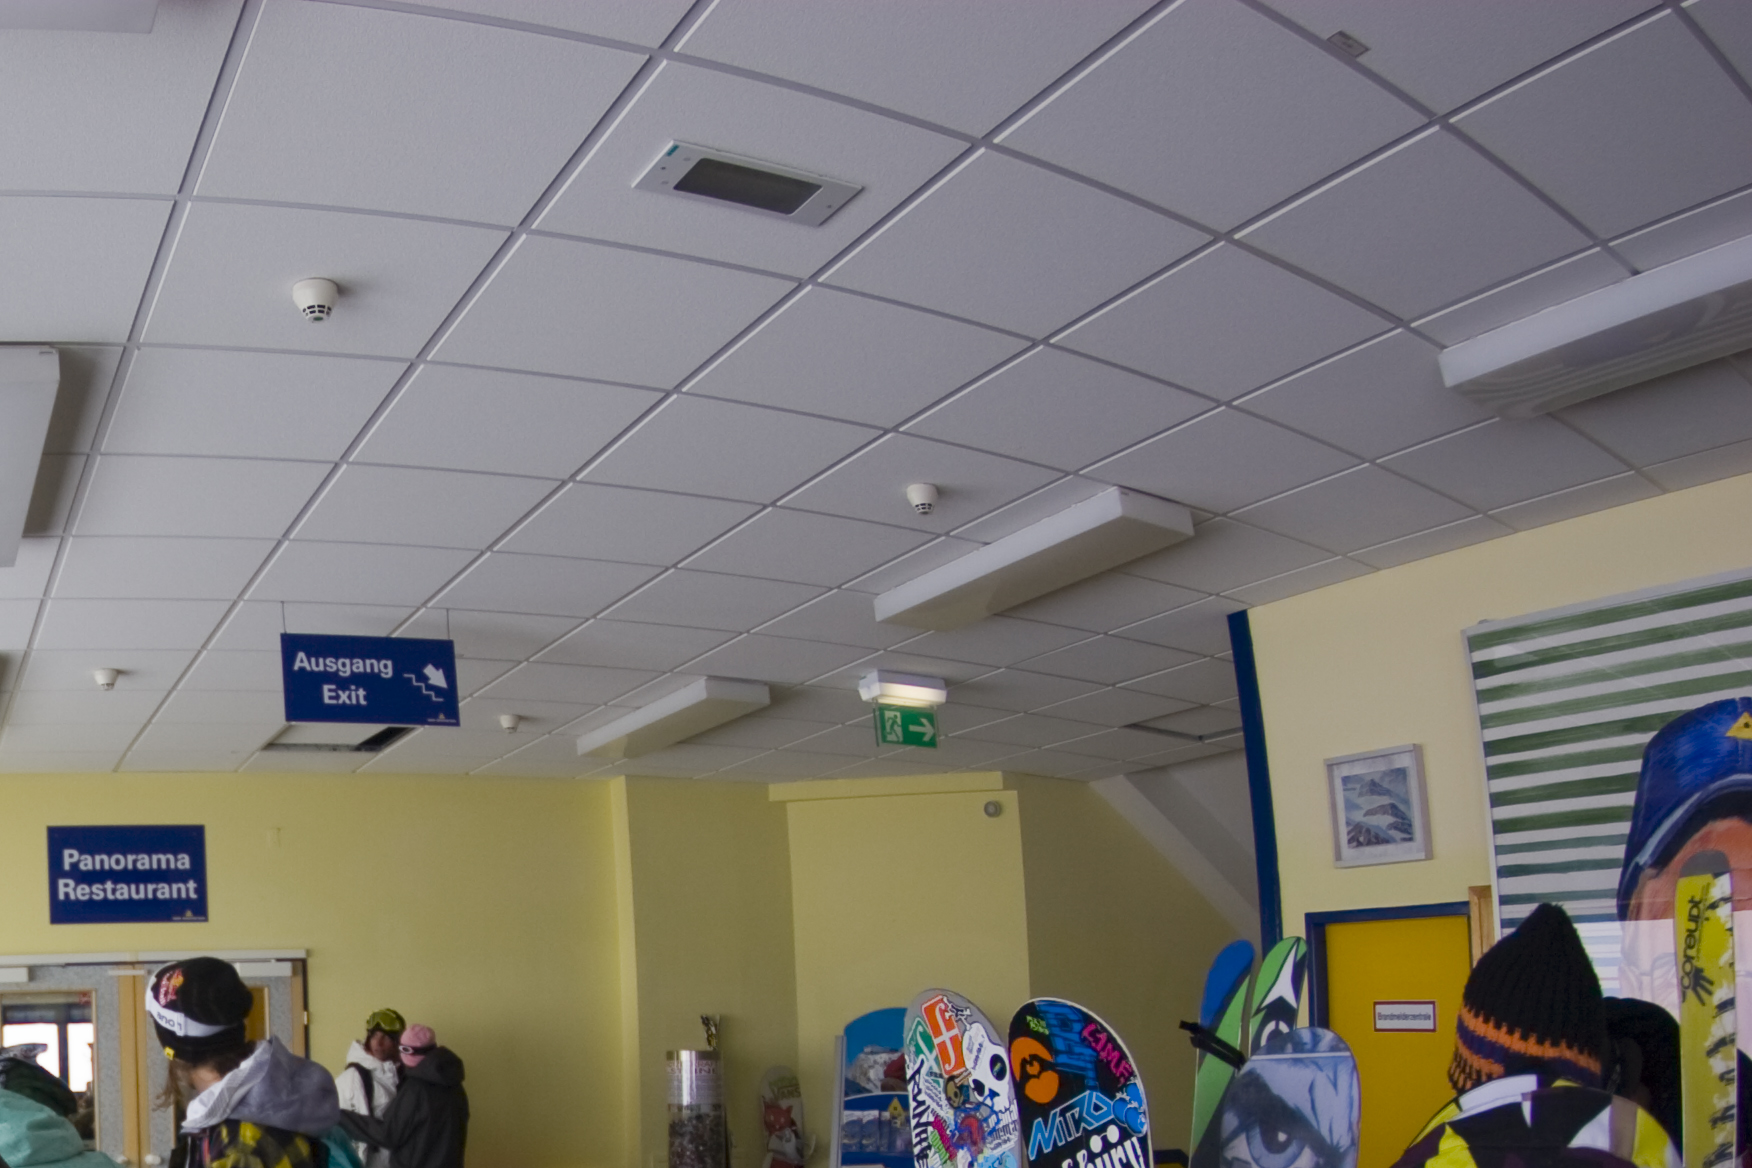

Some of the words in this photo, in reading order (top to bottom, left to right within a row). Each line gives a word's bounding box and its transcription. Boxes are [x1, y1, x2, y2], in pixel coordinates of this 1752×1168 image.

[293, 651, 394, 678] Ausgang
[323, 685, 367, 706] Exit
[62, 849, 191, 871] Panorama
[57, 878, 198, 901] Restaurant
[1028, 1090, 1115, 1161] NITRO
